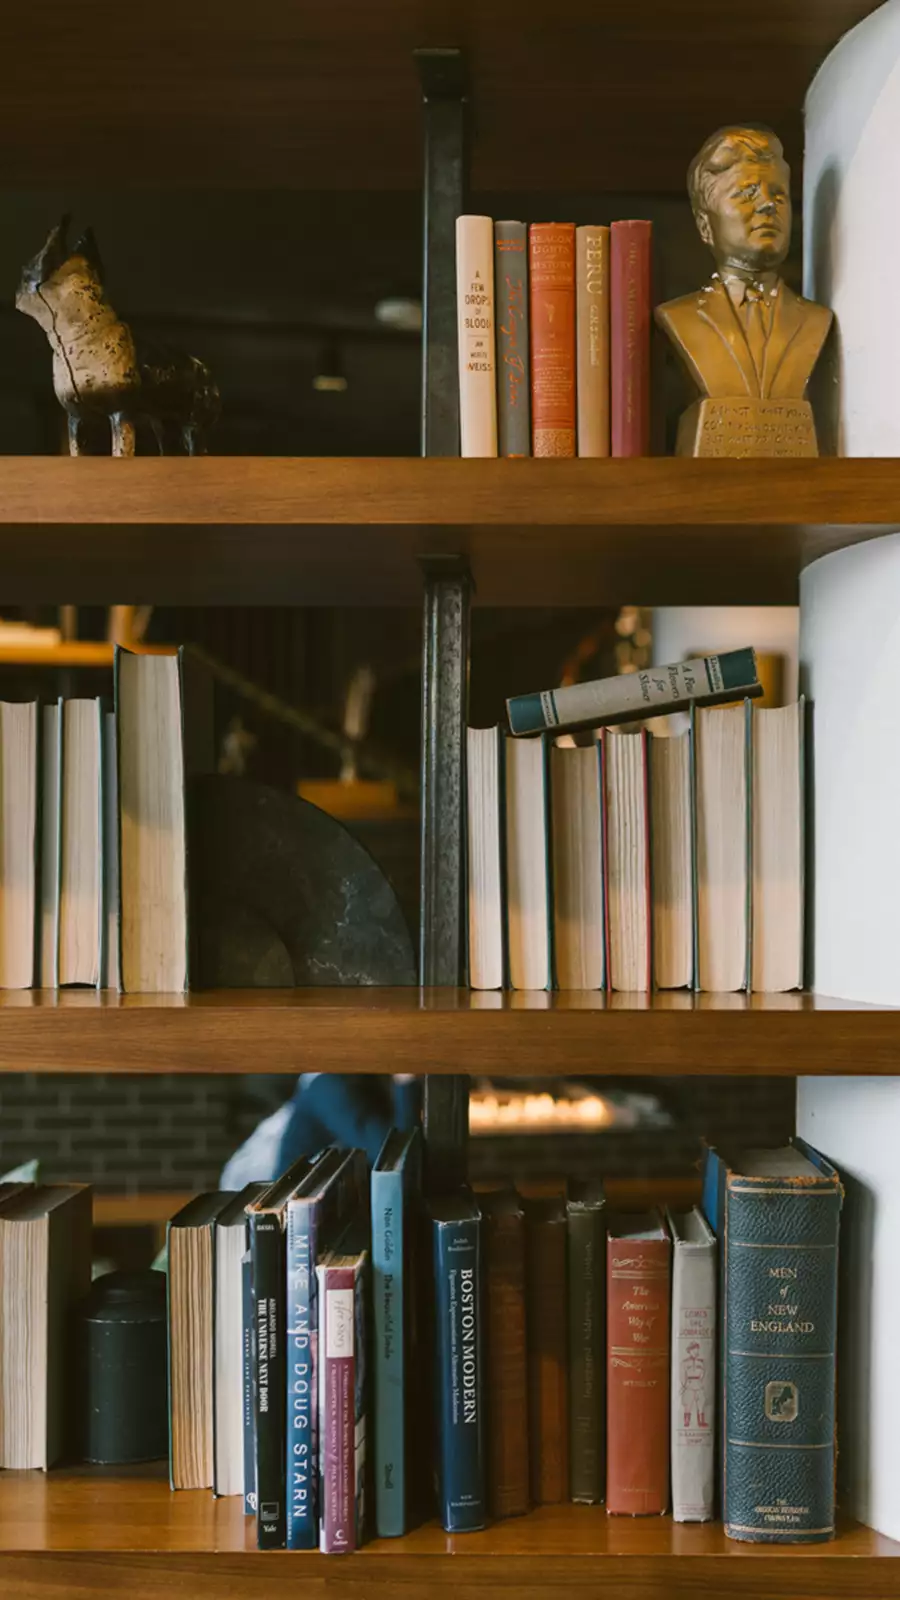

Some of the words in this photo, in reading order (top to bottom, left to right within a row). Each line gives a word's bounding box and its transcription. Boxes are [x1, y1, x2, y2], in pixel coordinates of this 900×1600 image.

[532, 245, 570, 254] LIGHTS
[475, 270, 480, 278] A
[586, 236, 602, 295] PERU
[470, 283, 484, 292] FEW
[464, 295, 491, 305] DROPS
[464, 318, 491, 328] BLOOD
[467, 363, 493, 372] WEISS
[652, 678, 666, 692] for
[668, 666, 680, 700] Flowers
[384, 1208, 393, 1228] Nan
[384, 1230, 394, 1262] Goldin
[294, 1234, 309, 1290] MIKE
[770, 1268, 797, 1278] MEN
[384, 1274, 394, 1290] The
[632, 1286, 650, 1296] The
[780, 1285, 790, 1300] of
[258, 1298, 268, 1317] THE
[384, 1292, 394, 1332] Beautiful
[461, 1268, 474, 1341] BOSTON
[768, 1304, 798, 1316] NEW
[294, 1304, 308, 1350] AND
[628, 1316, 644, 1330] Way
[750, 1320, 814, 1332] ENGLAND
[258, 1318, 268, 1361] UNIVERSE
[258, 1362, 268, 1386] NEXT
[462, 1344, 476, 1424] MODERN
[259, 1387, 269, 1413] DOOR
[294, 1363, 308, 1430] DOUG
[293, 1443, 308, 1518] STARN
[262, 1524, 277, 1532] Yale
